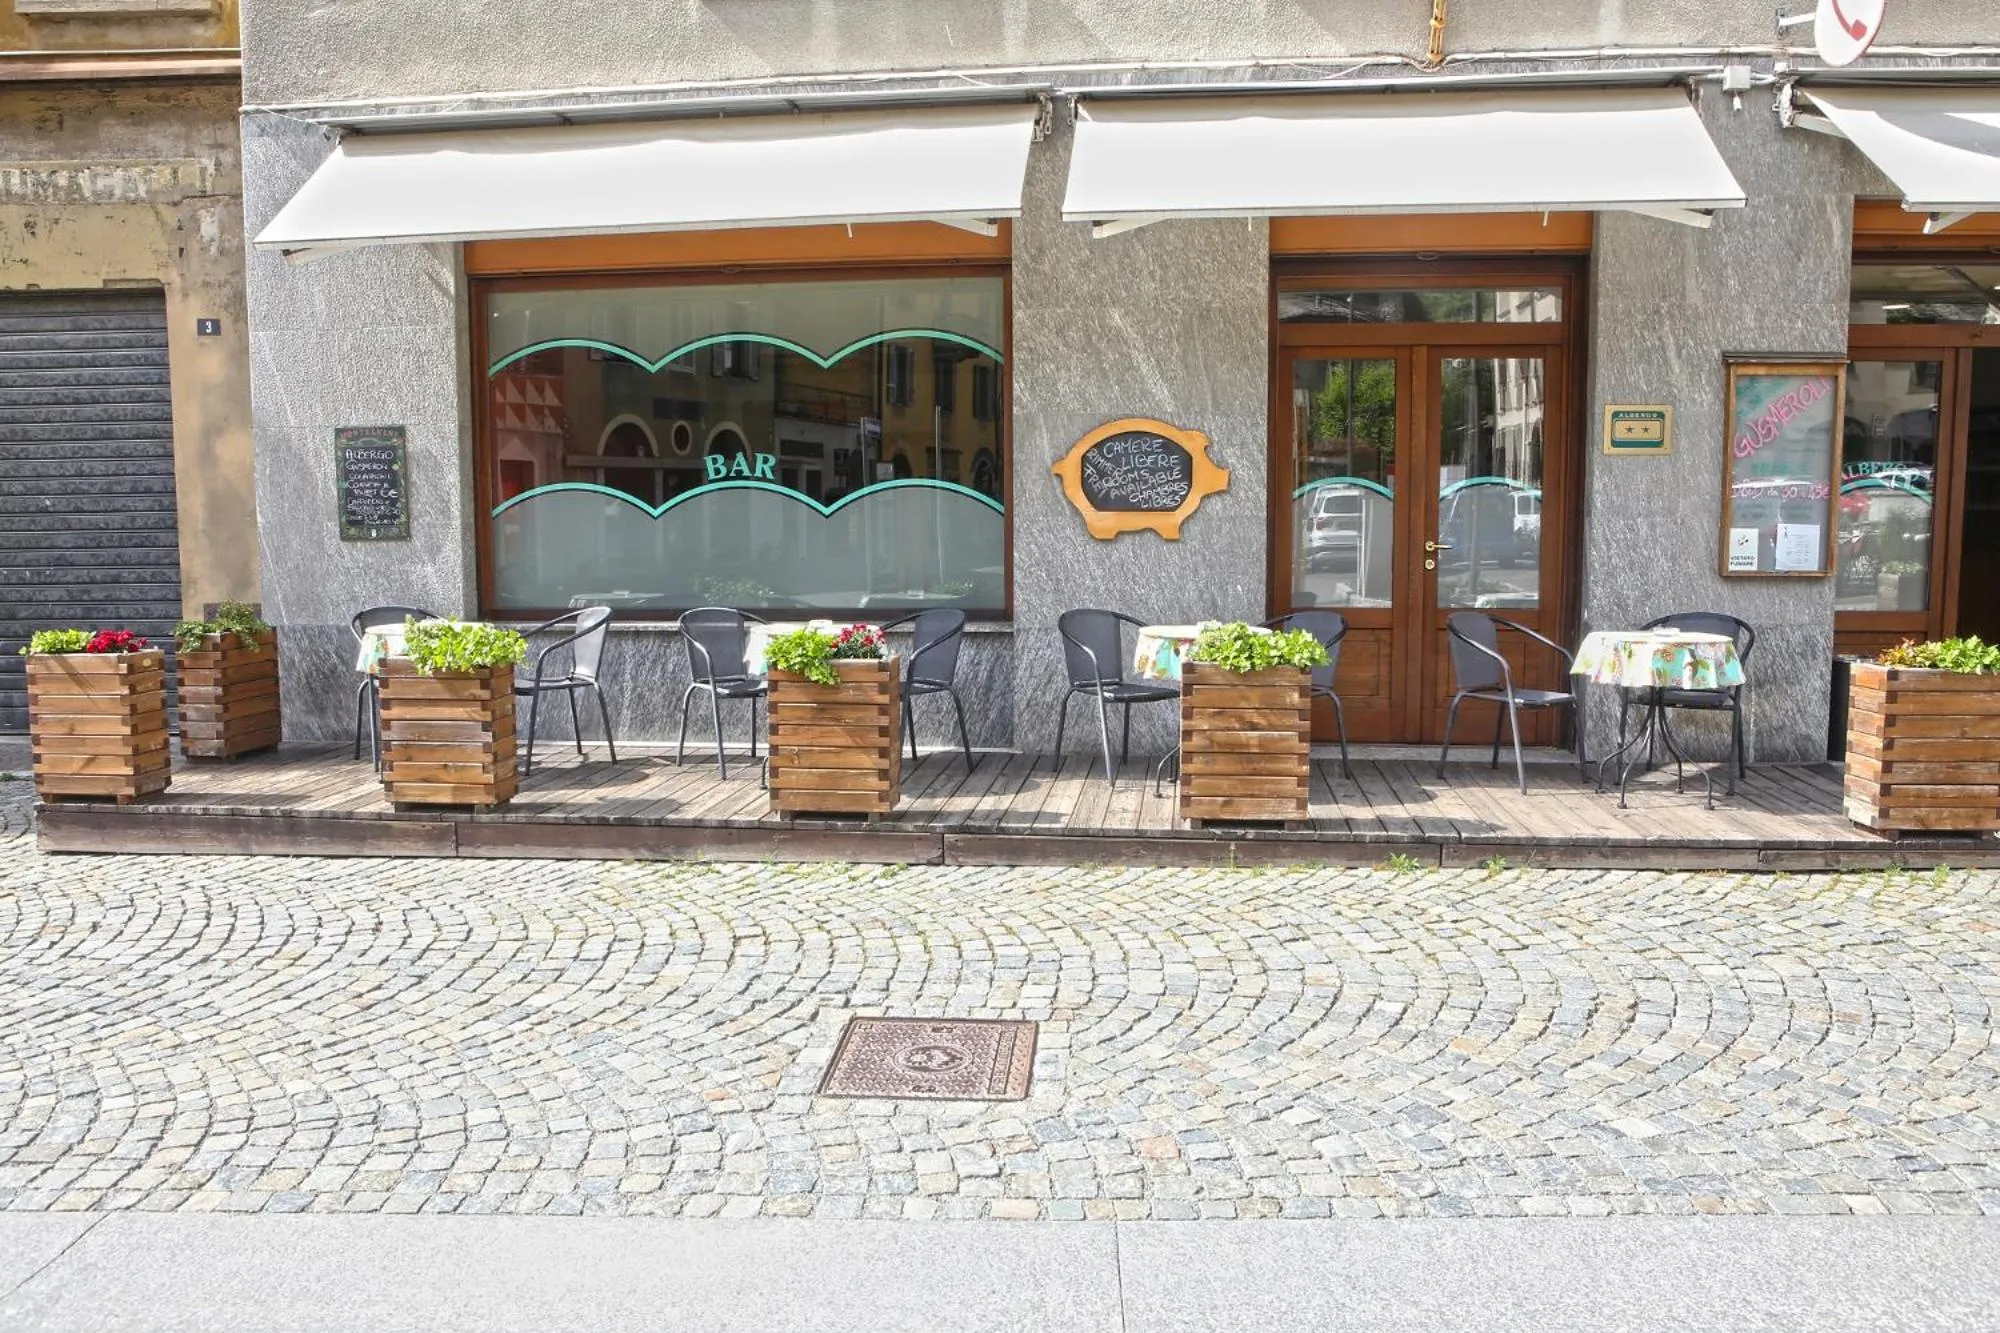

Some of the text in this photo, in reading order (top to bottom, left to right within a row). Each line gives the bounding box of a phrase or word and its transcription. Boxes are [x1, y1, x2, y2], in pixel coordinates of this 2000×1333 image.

[205, 321, 212, 333] 3
[345, 448, 394, 460] ALBERGO
[1103, 438, 1164, 458] CAMERE
[704, 451, 777, 480] BAR
[1086, 448, 1123, 479] ZIMMER
[1122, 454, 1180, 471] LIBERE
[1102, 470, 1150, 488] ROOMS
[1110, 467, 1183, 500] AVAILABLE
[1129, 481, 1189, 502] CHAMBRES
[1140, 495, 1182, 508] LIBRES
